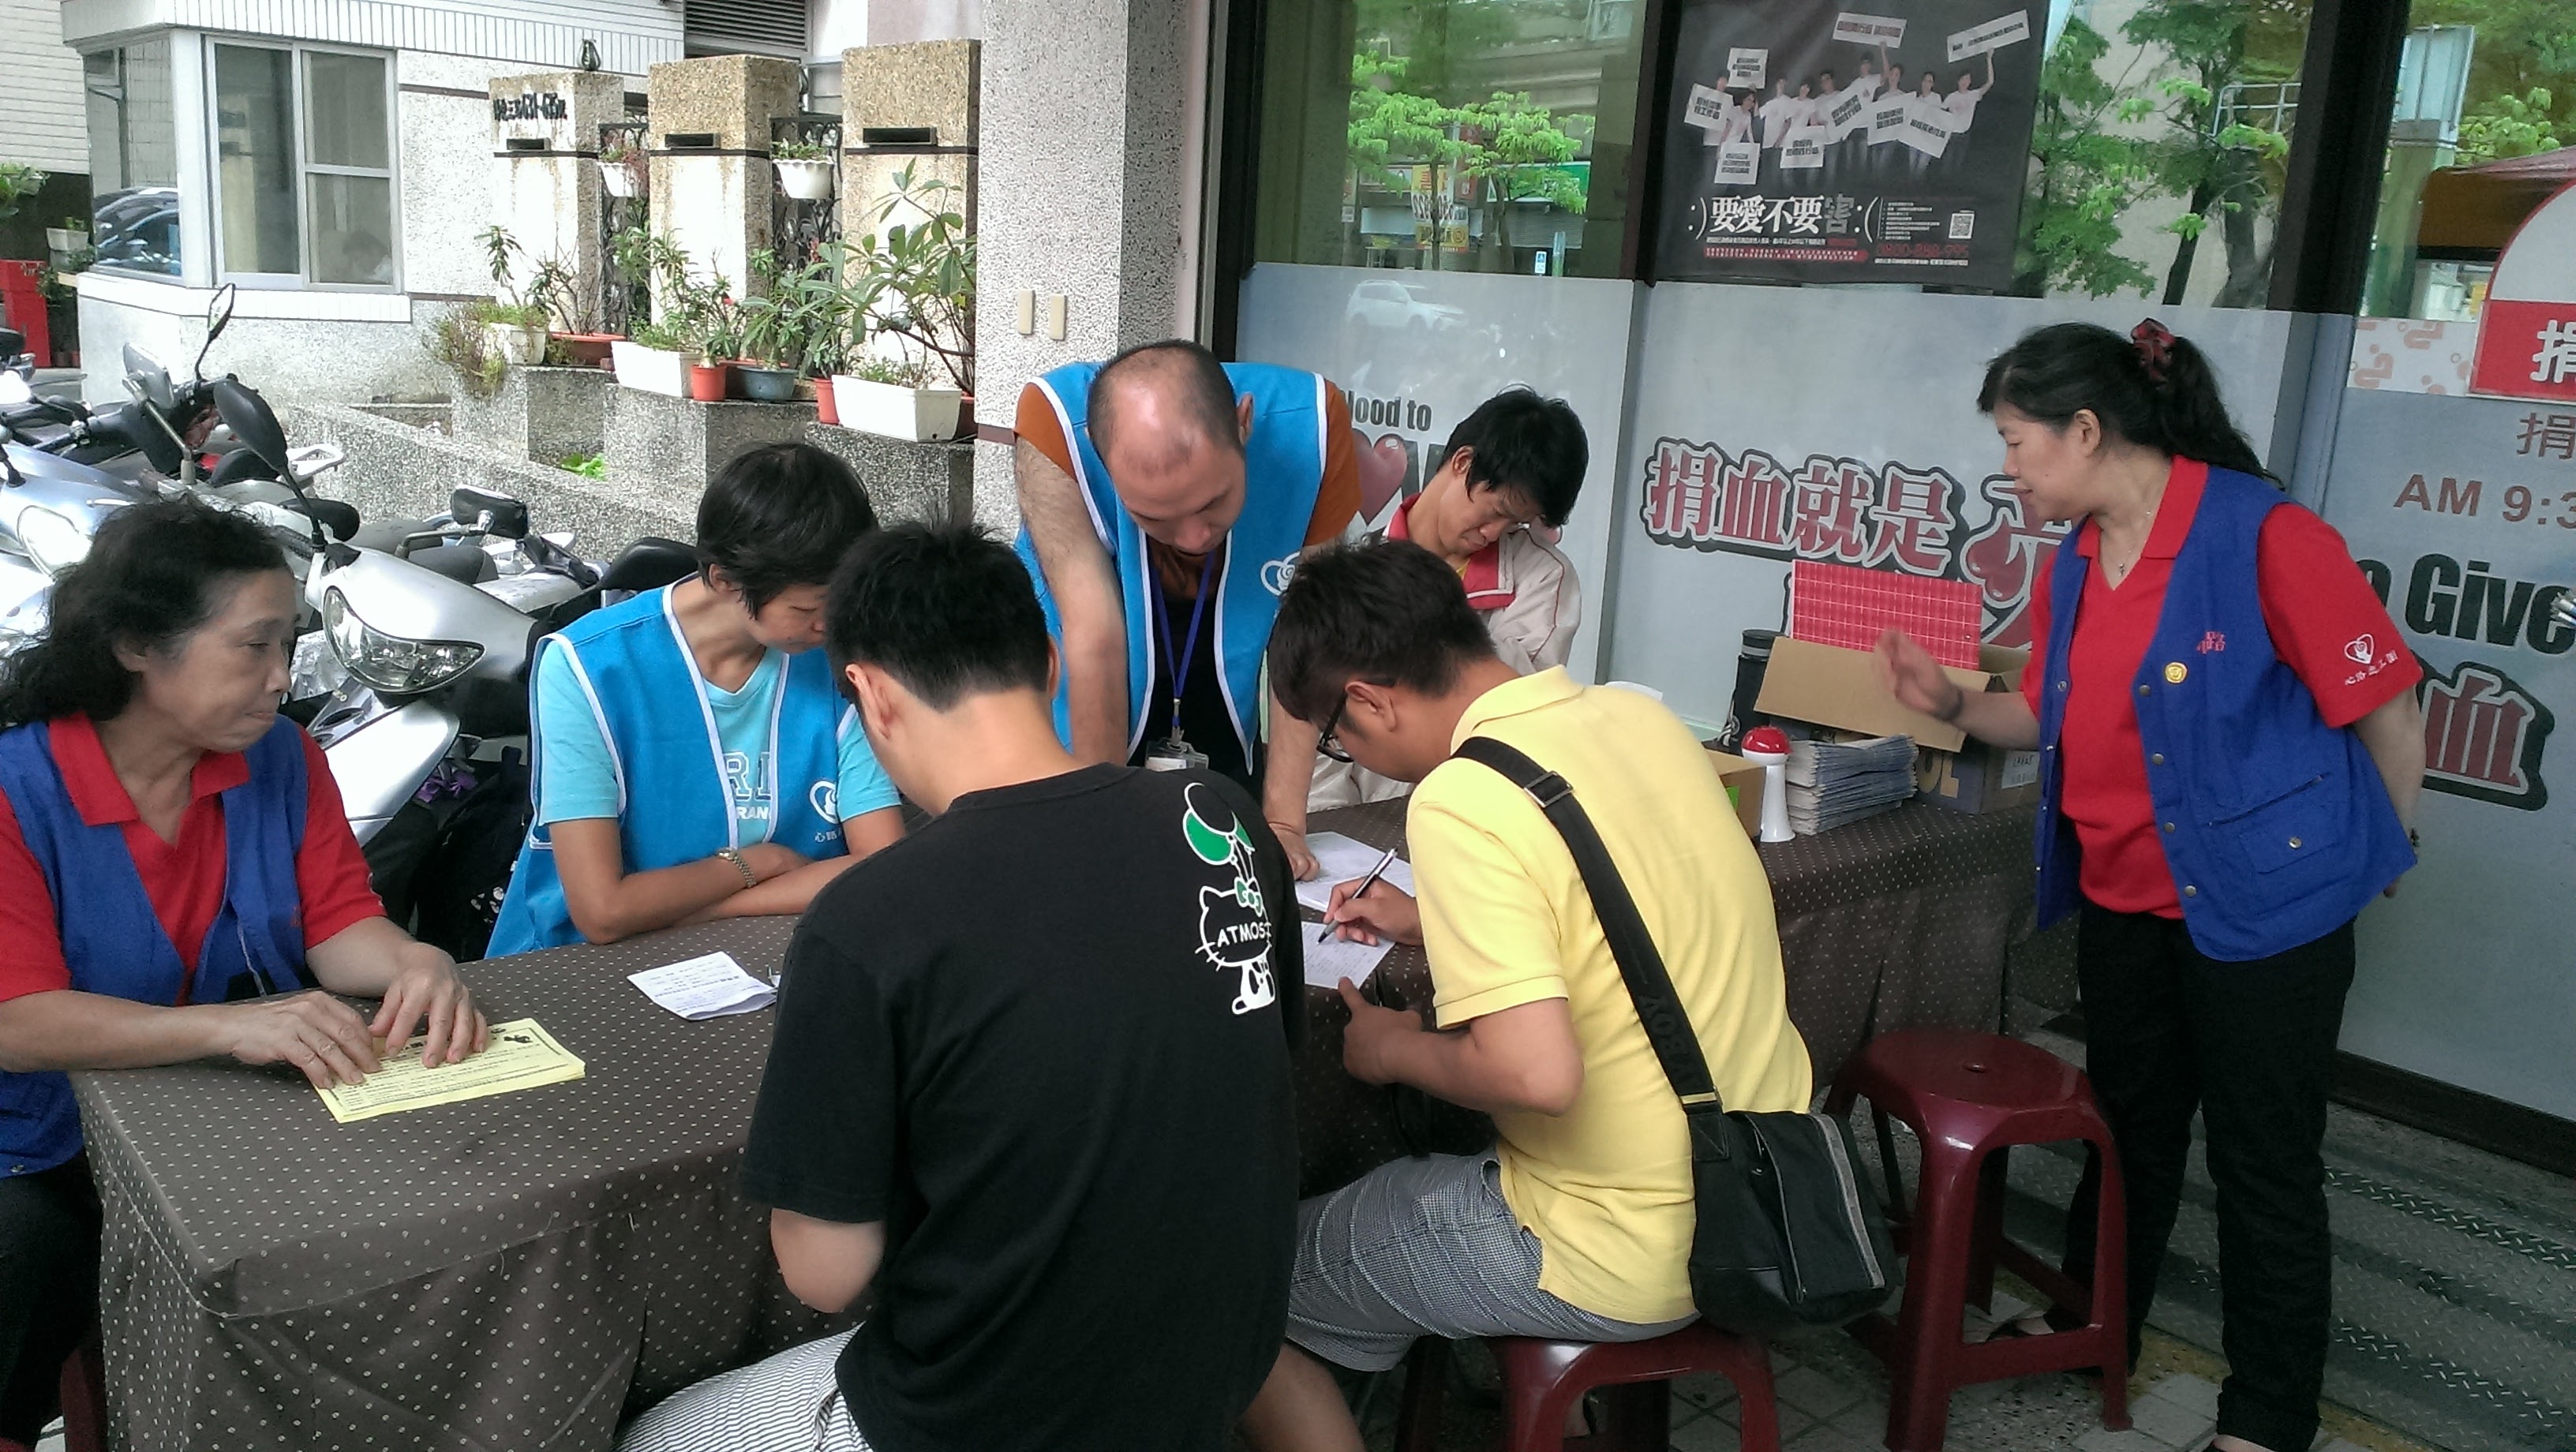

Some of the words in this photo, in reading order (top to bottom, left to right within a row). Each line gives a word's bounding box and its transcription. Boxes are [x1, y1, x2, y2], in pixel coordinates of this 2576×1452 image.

[1341, 389, 1402, 428] lood
[1406, 399, 1432, 432] to
[2393, 473, 2483, 517] AM
[2405, 553, 2576, 654] Give
[736, 806, 772, 820] RAN
